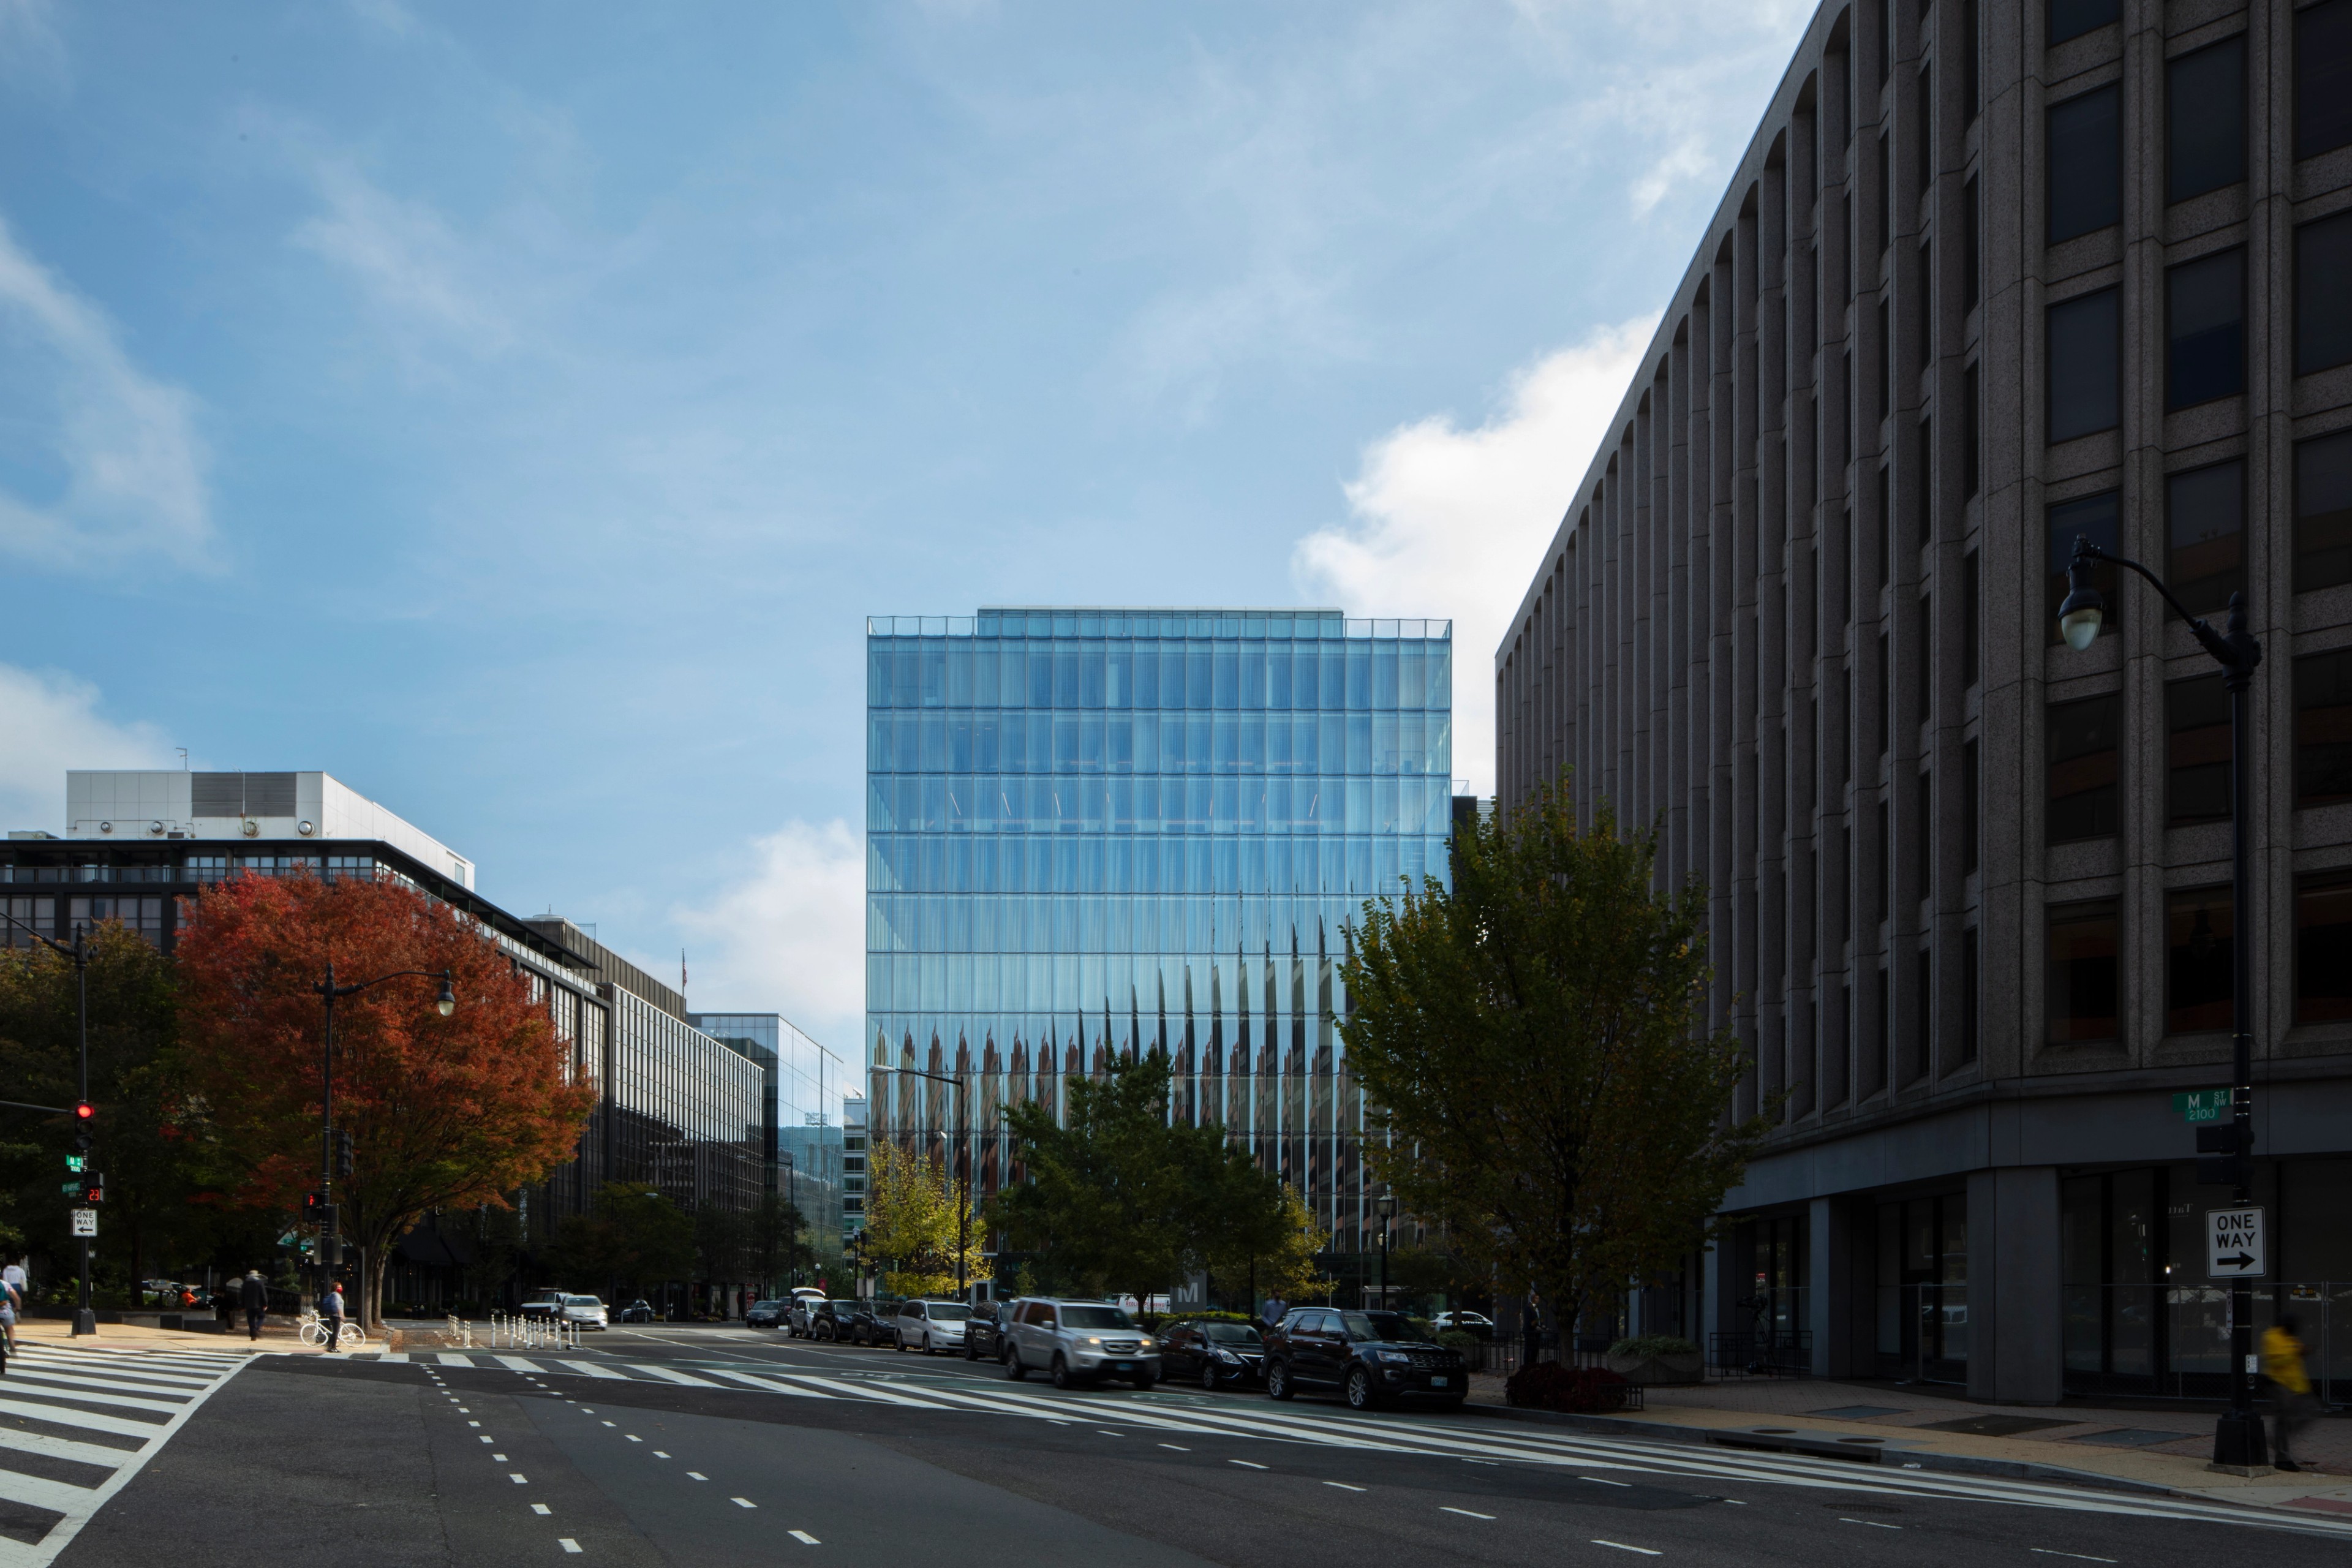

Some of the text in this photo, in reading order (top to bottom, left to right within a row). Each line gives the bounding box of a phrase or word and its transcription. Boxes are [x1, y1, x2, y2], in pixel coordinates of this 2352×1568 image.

[2214, 1091, 2225, 1099] ST
[2188, 1093, 2200, 1109] M
[2214, 1098, 2226, 1107] NW
[2188, 1109, 2215, 1120] 2100
[70, 1156, 75, 1165] M
[89, 1189, 99, 1200] 23
[2217, 1214, 2254, 1230] ONE
[2216, 1232, 2256, 1248] WAY
[1178, 1282, 1198, 1303] M
